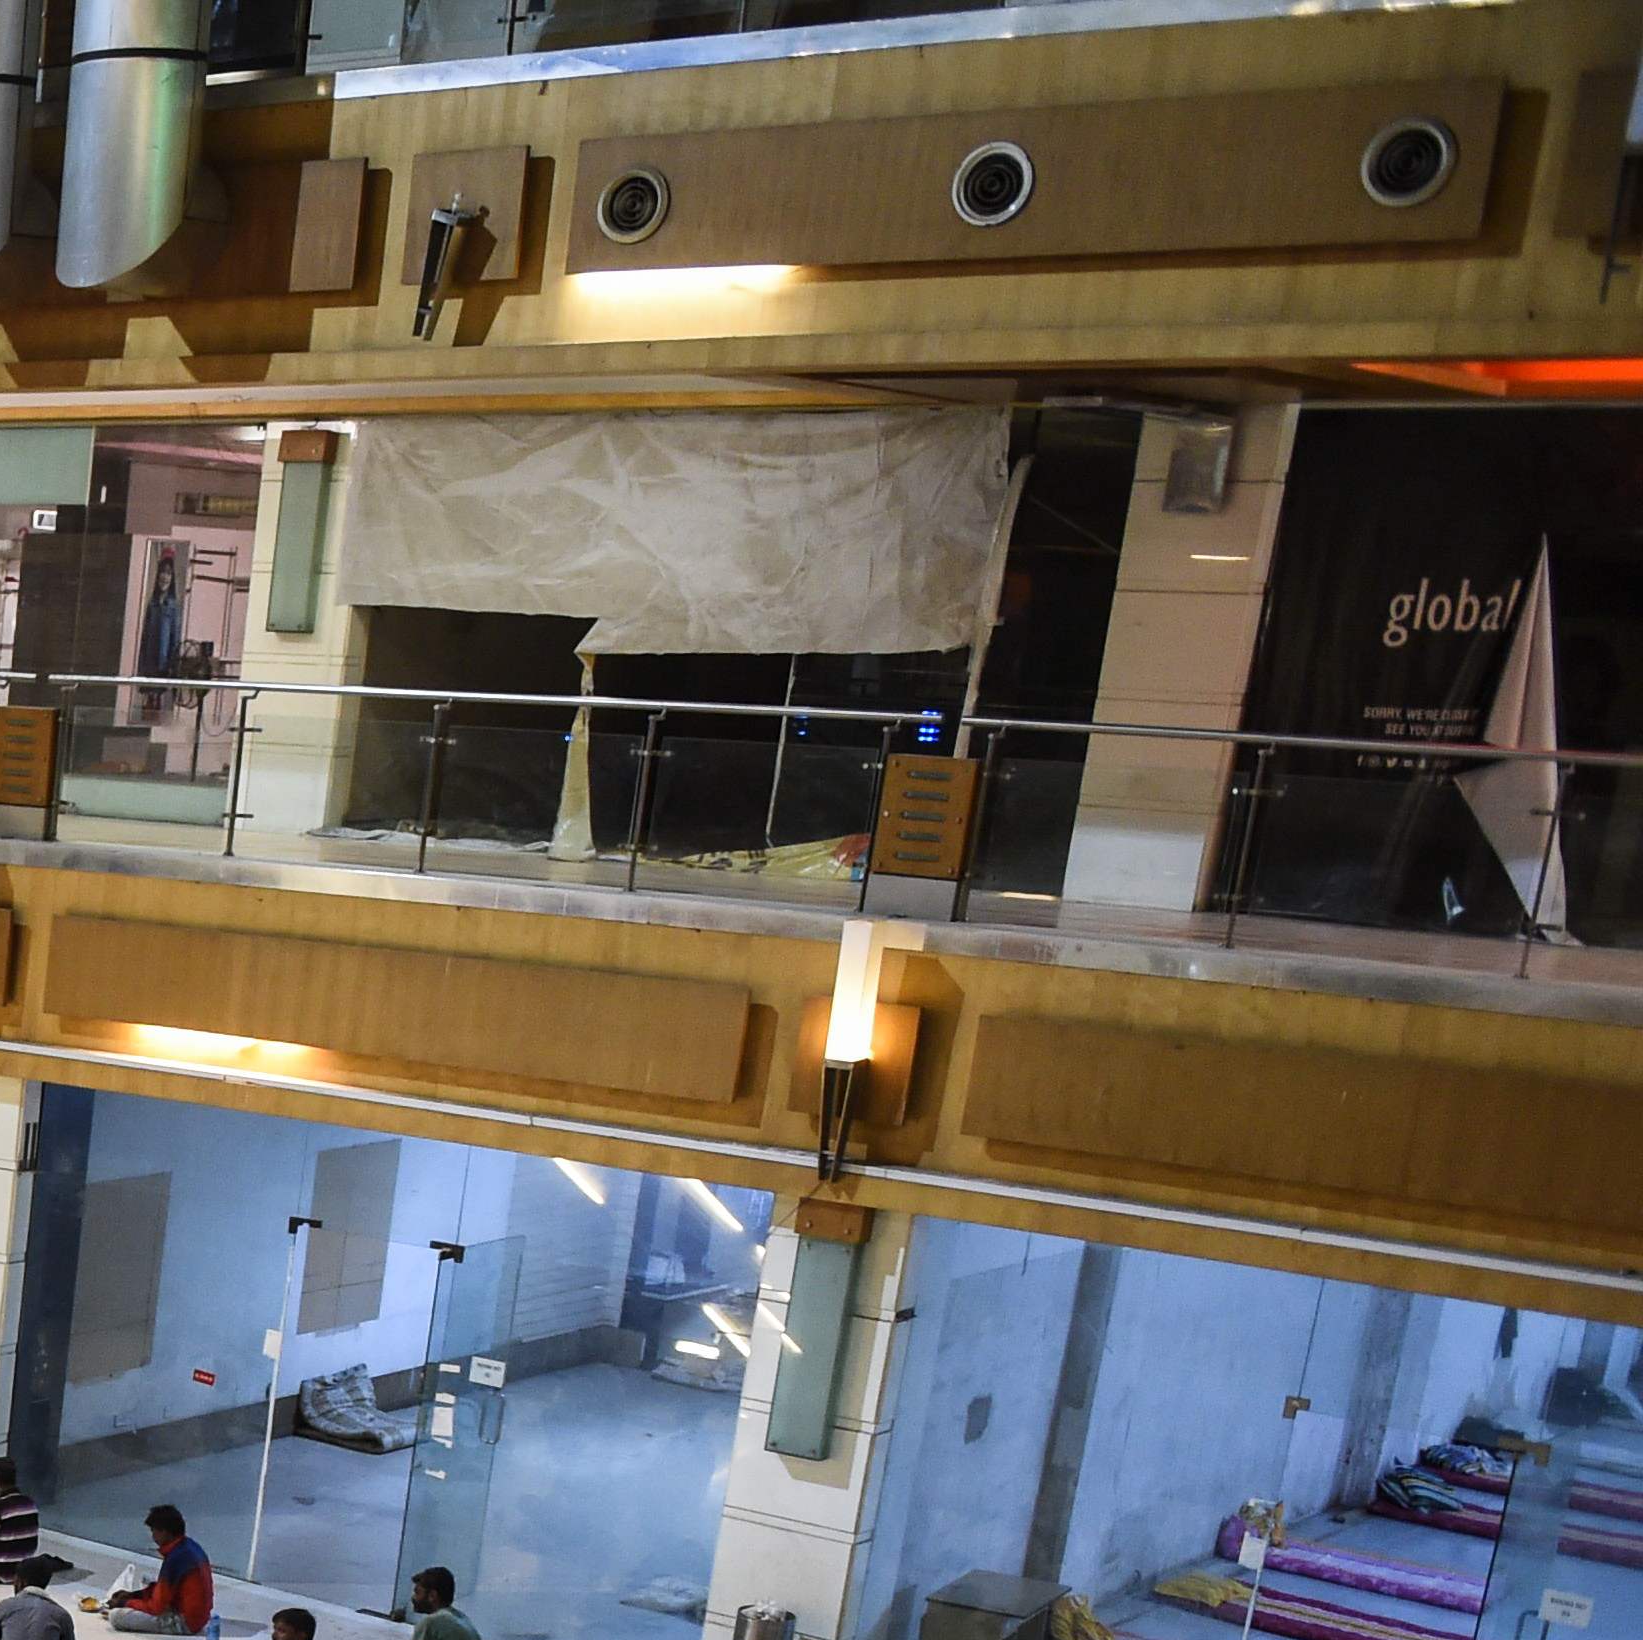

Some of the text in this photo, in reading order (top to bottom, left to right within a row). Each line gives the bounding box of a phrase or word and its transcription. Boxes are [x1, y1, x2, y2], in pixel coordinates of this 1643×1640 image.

[1382, 577, 1522, 647] global
[1384, 723, 1406, 736] SEE
[1409, 724, 1430, 737] YOU
